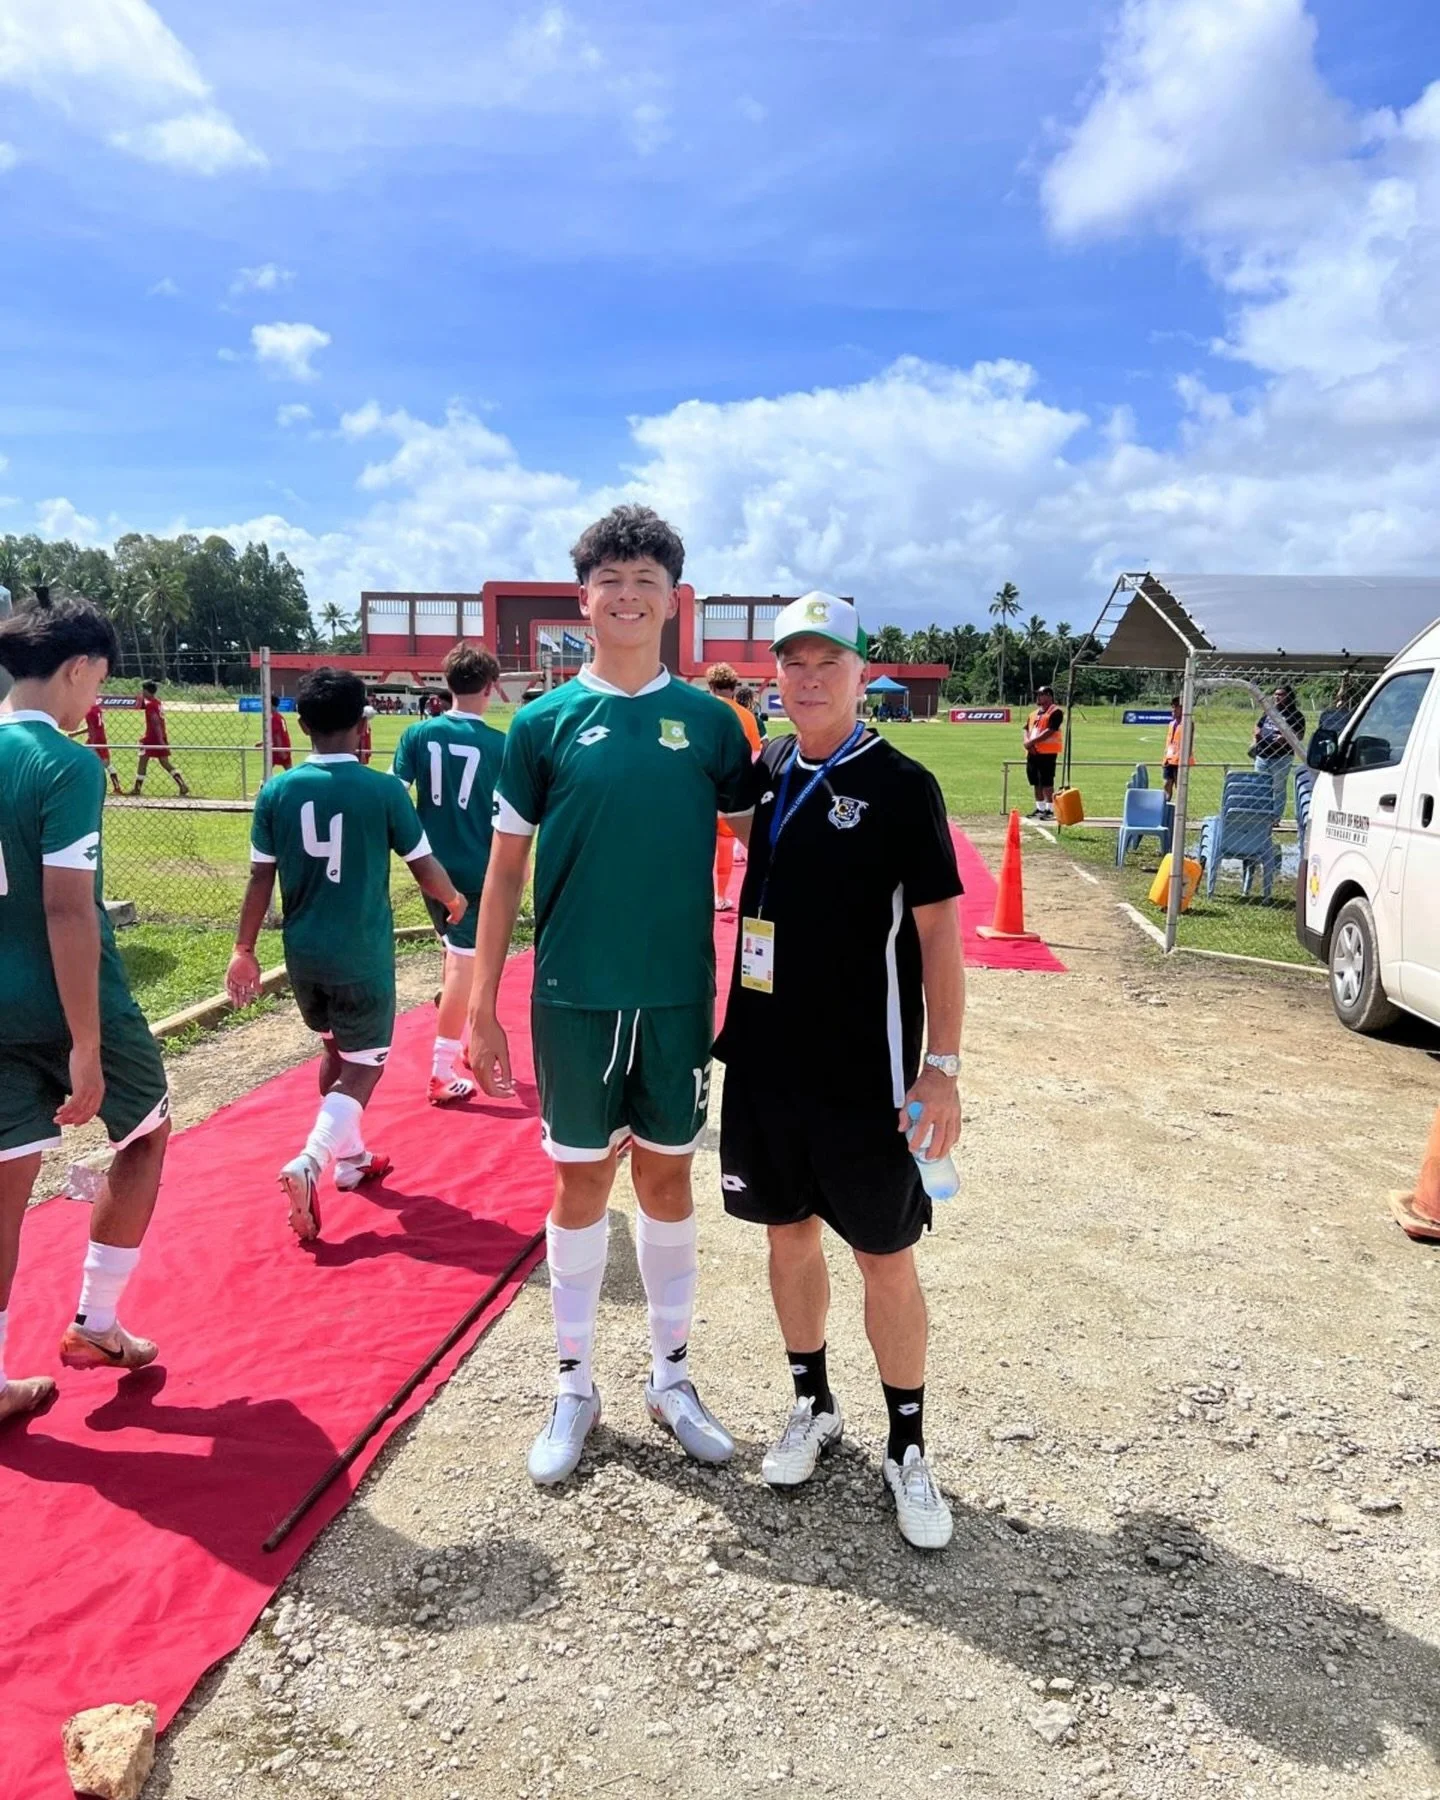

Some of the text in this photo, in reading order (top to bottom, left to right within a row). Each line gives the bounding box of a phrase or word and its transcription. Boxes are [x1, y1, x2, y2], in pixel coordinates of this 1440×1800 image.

[967, 712, 1004, 720] LOTTO
[427, 741, 481, 810] 17
[300, 800, 343, 883] 4
[1327, 809, 1369, 831] MINISTRY OF HEALTH
